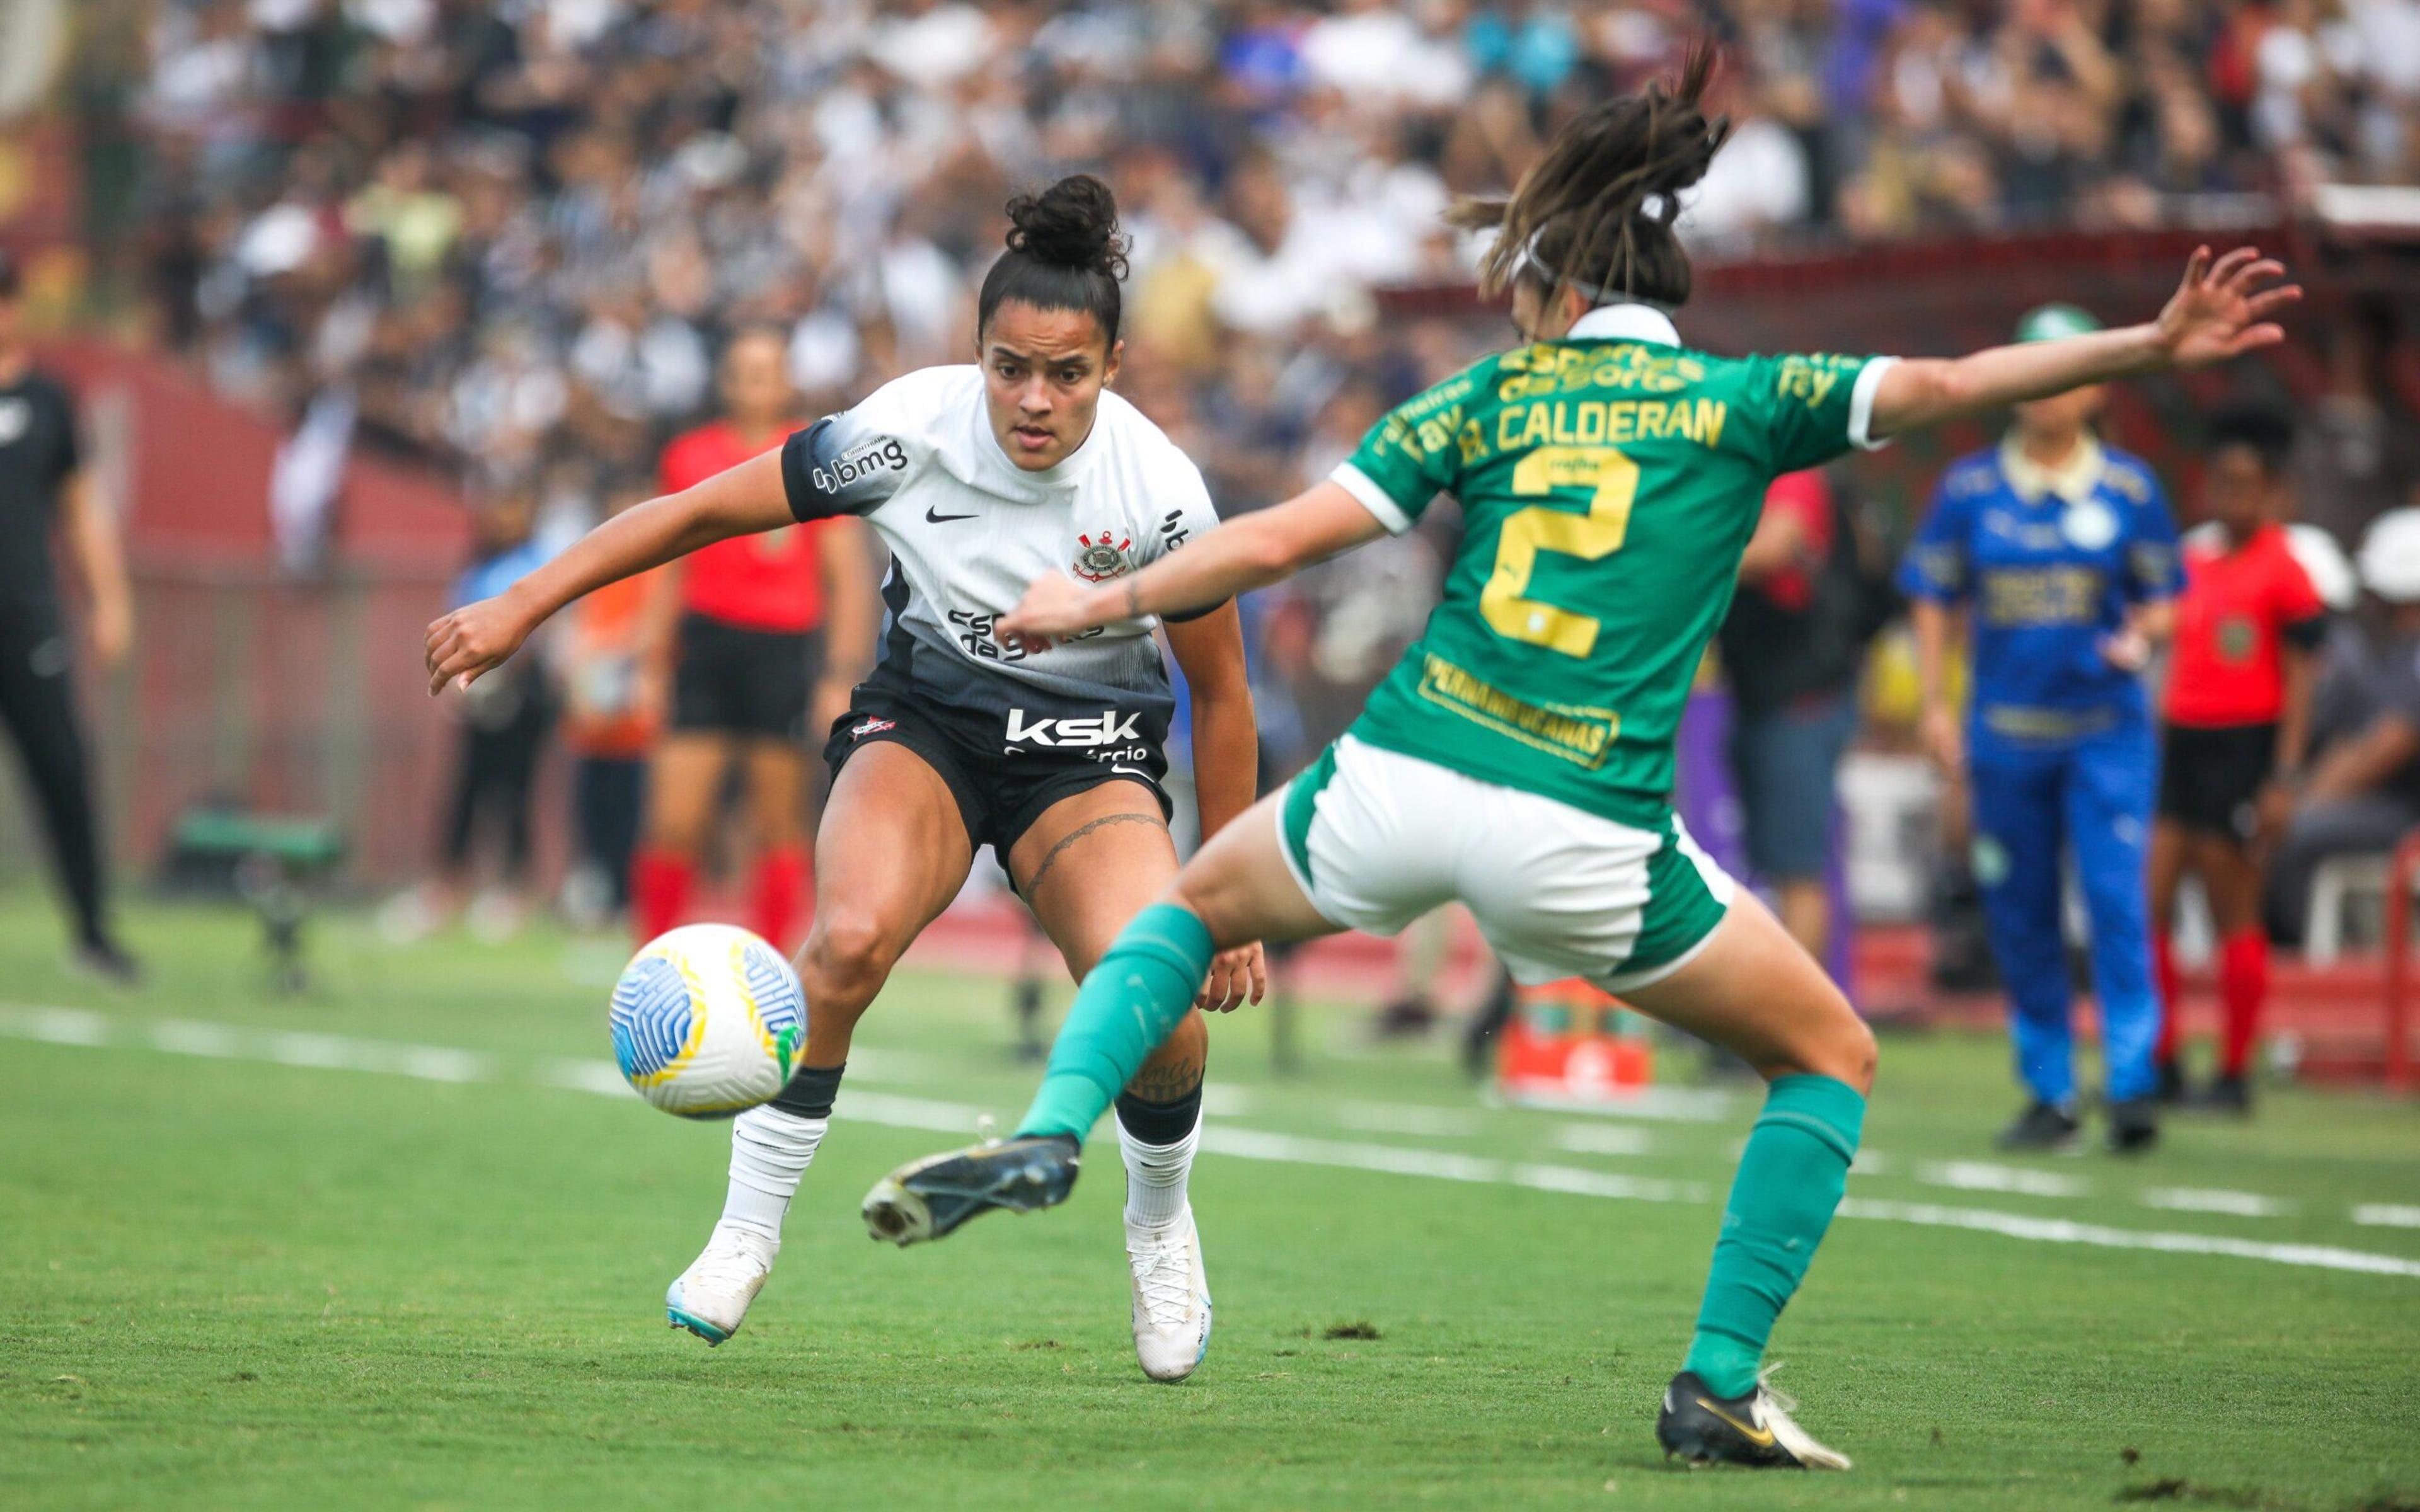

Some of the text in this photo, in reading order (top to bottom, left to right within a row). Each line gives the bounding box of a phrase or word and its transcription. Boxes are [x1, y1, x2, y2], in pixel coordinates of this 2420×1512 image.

[1496, 397, 1727, 452] CALDERAN
[831, 440, 908, 488] bmg
[1479, 445, 1640, 659] 2
